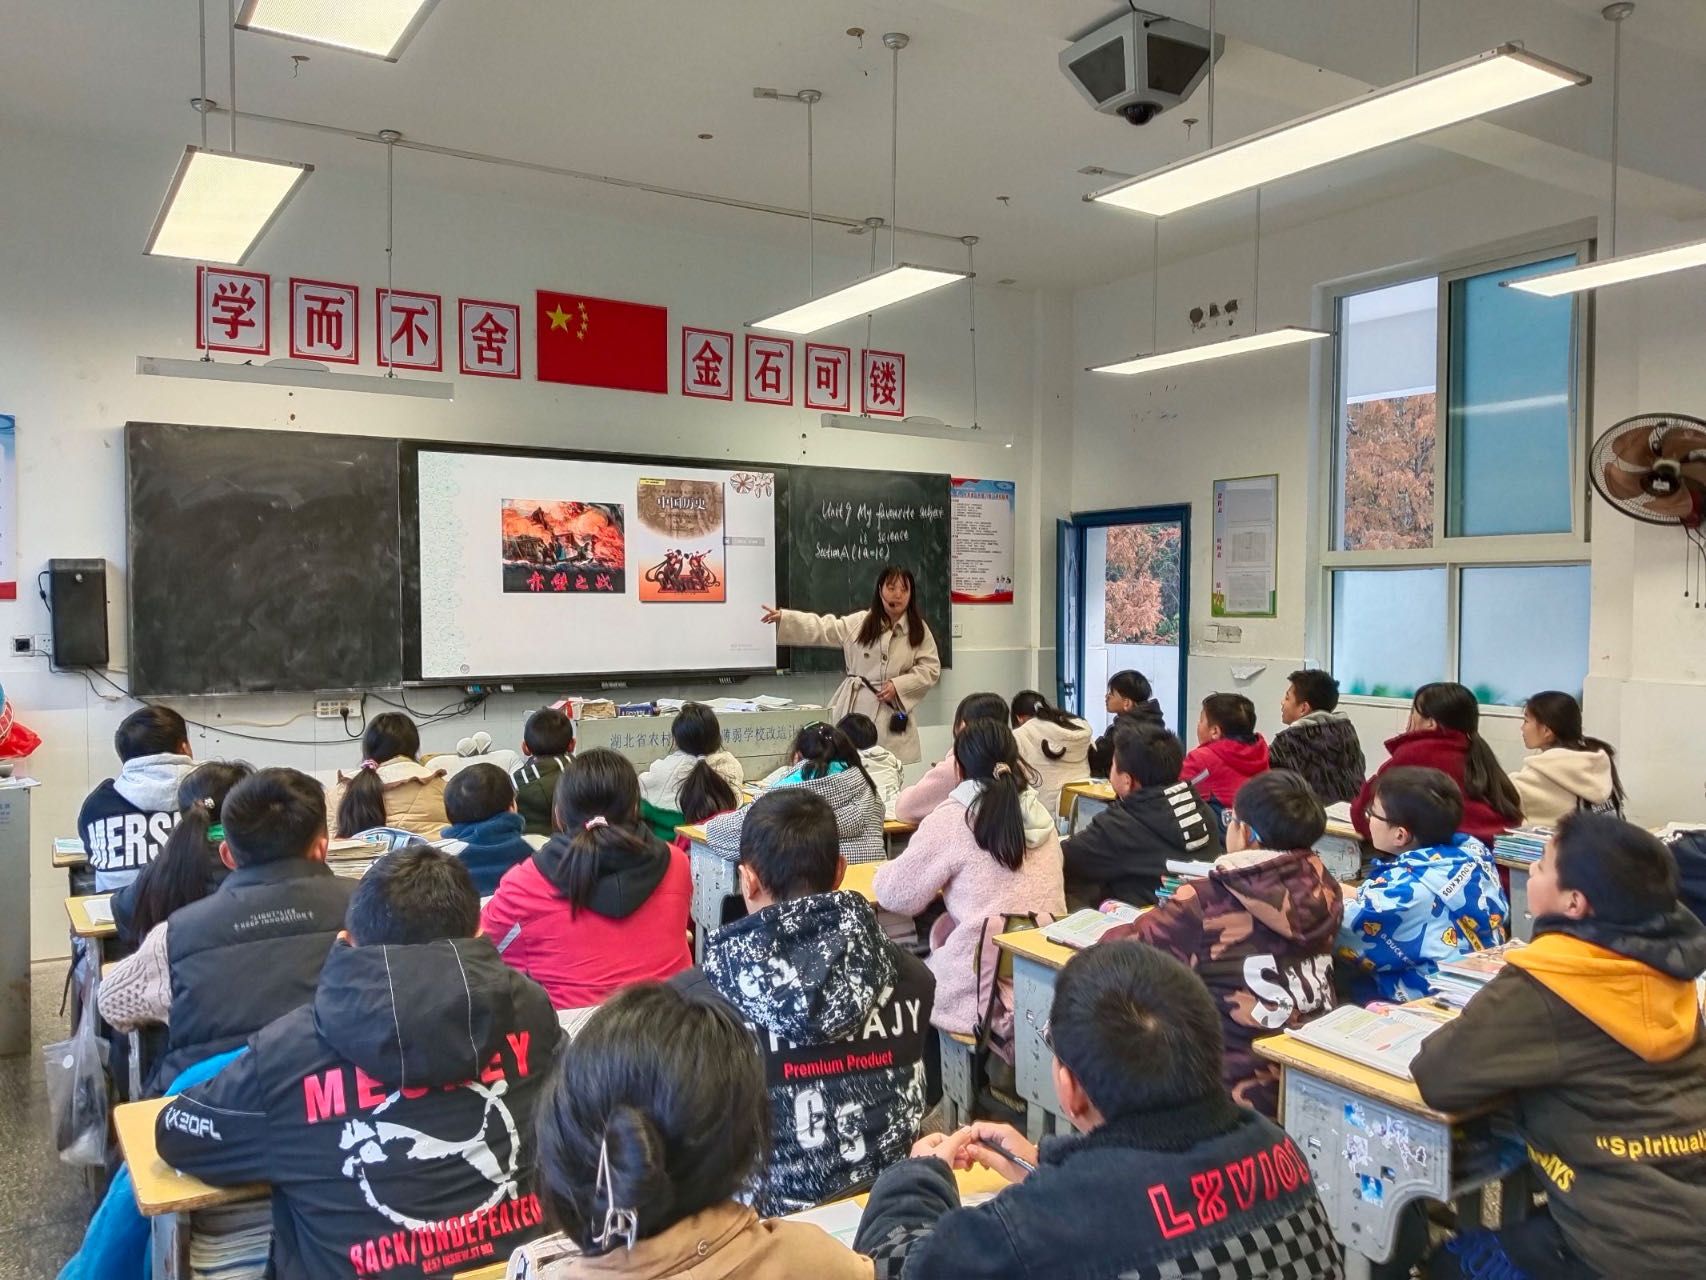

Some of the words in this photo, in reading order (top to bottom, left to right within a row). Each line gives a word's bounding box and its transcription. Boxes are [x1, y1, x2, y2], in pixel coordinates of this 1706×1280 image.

[857, 502, 872, 529] My
[87, 810, 184, 870] MERS
[783, 1058, 845, 1081] Premium
[846, 1050, 894, 1072] Product
